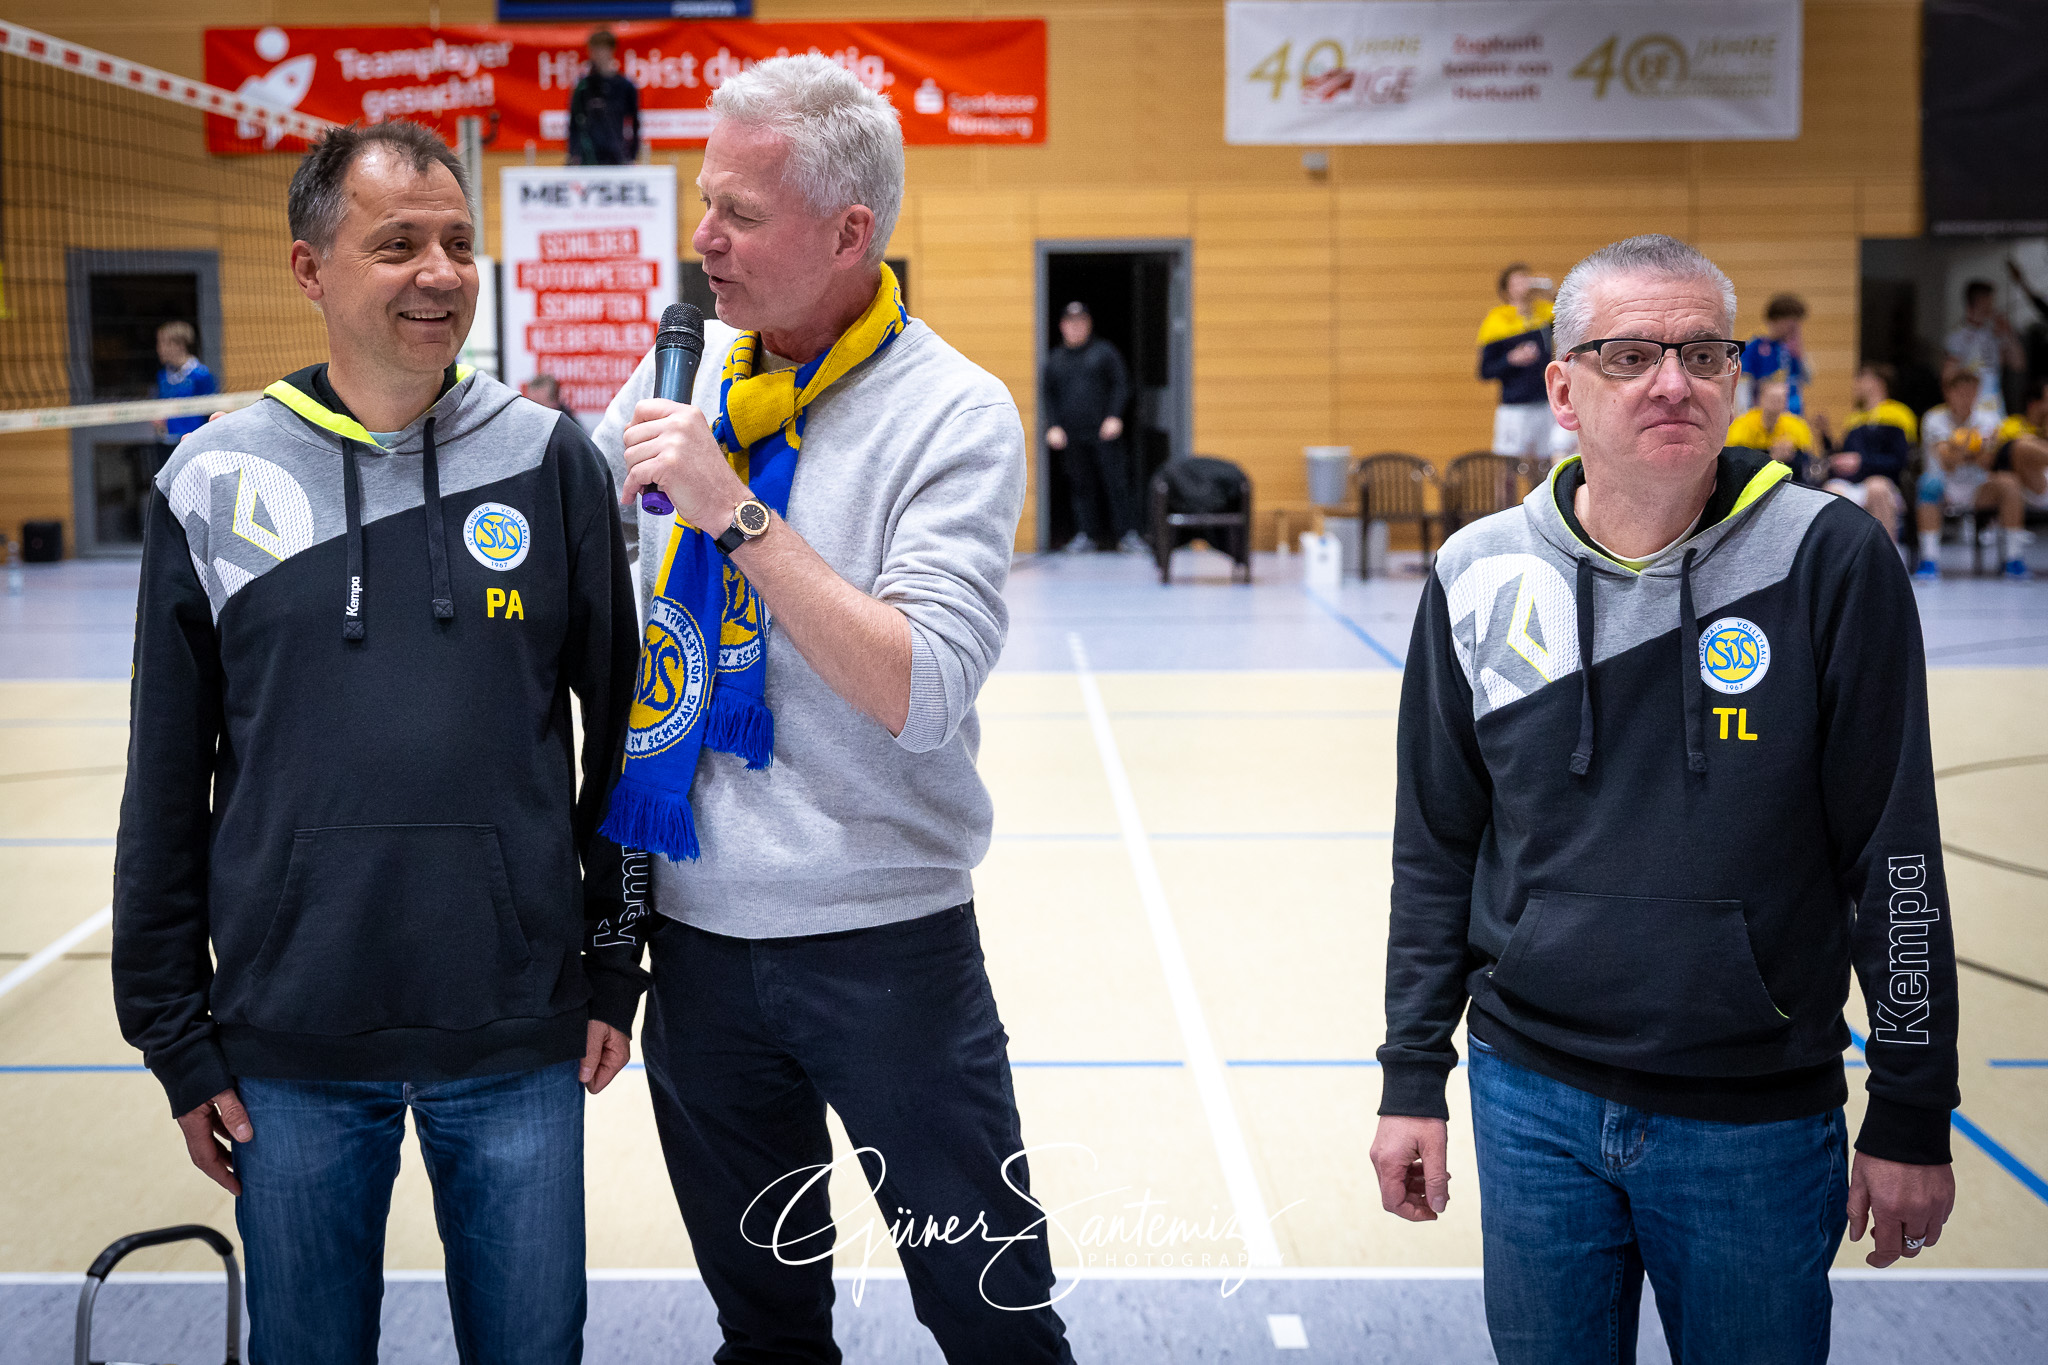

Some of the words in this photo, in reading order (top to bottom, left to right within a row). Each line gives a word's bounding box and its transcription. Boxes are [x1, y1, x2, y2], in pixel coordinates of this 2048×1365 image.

[334, 38, 514, 82] Teamplayer
[538, 51, 621, 90] Hi
[624, 49, 699, 88] bist
[361, 73, 494, 124] gesucht!
[520, 180, 656, 206] MEYSEL
[467, 506, 490, 534] SCHWAIG
[501, 507, 528, 549] VOLLEYBALL
[467, 537, 474, 546] SV
[491, 561, 508, 569] 1967
[345, 576, 363, 617] Kempa
[486, 587, 525, 621] PA
[736, 643, 761, 665] SCH
[1699, 623, 1723, 657] SCHWAIG
[1736, 622, 1767, 666] VOLLEYBALL
[1725, 683, 1744, 691] 1967
[647, 695, 697, 748] SCHWAIG
[1712, 707, 1759, 741] TL
[593, 845, 651, 947] Kem
[1875, 854, 1940, 1045] Kempa
